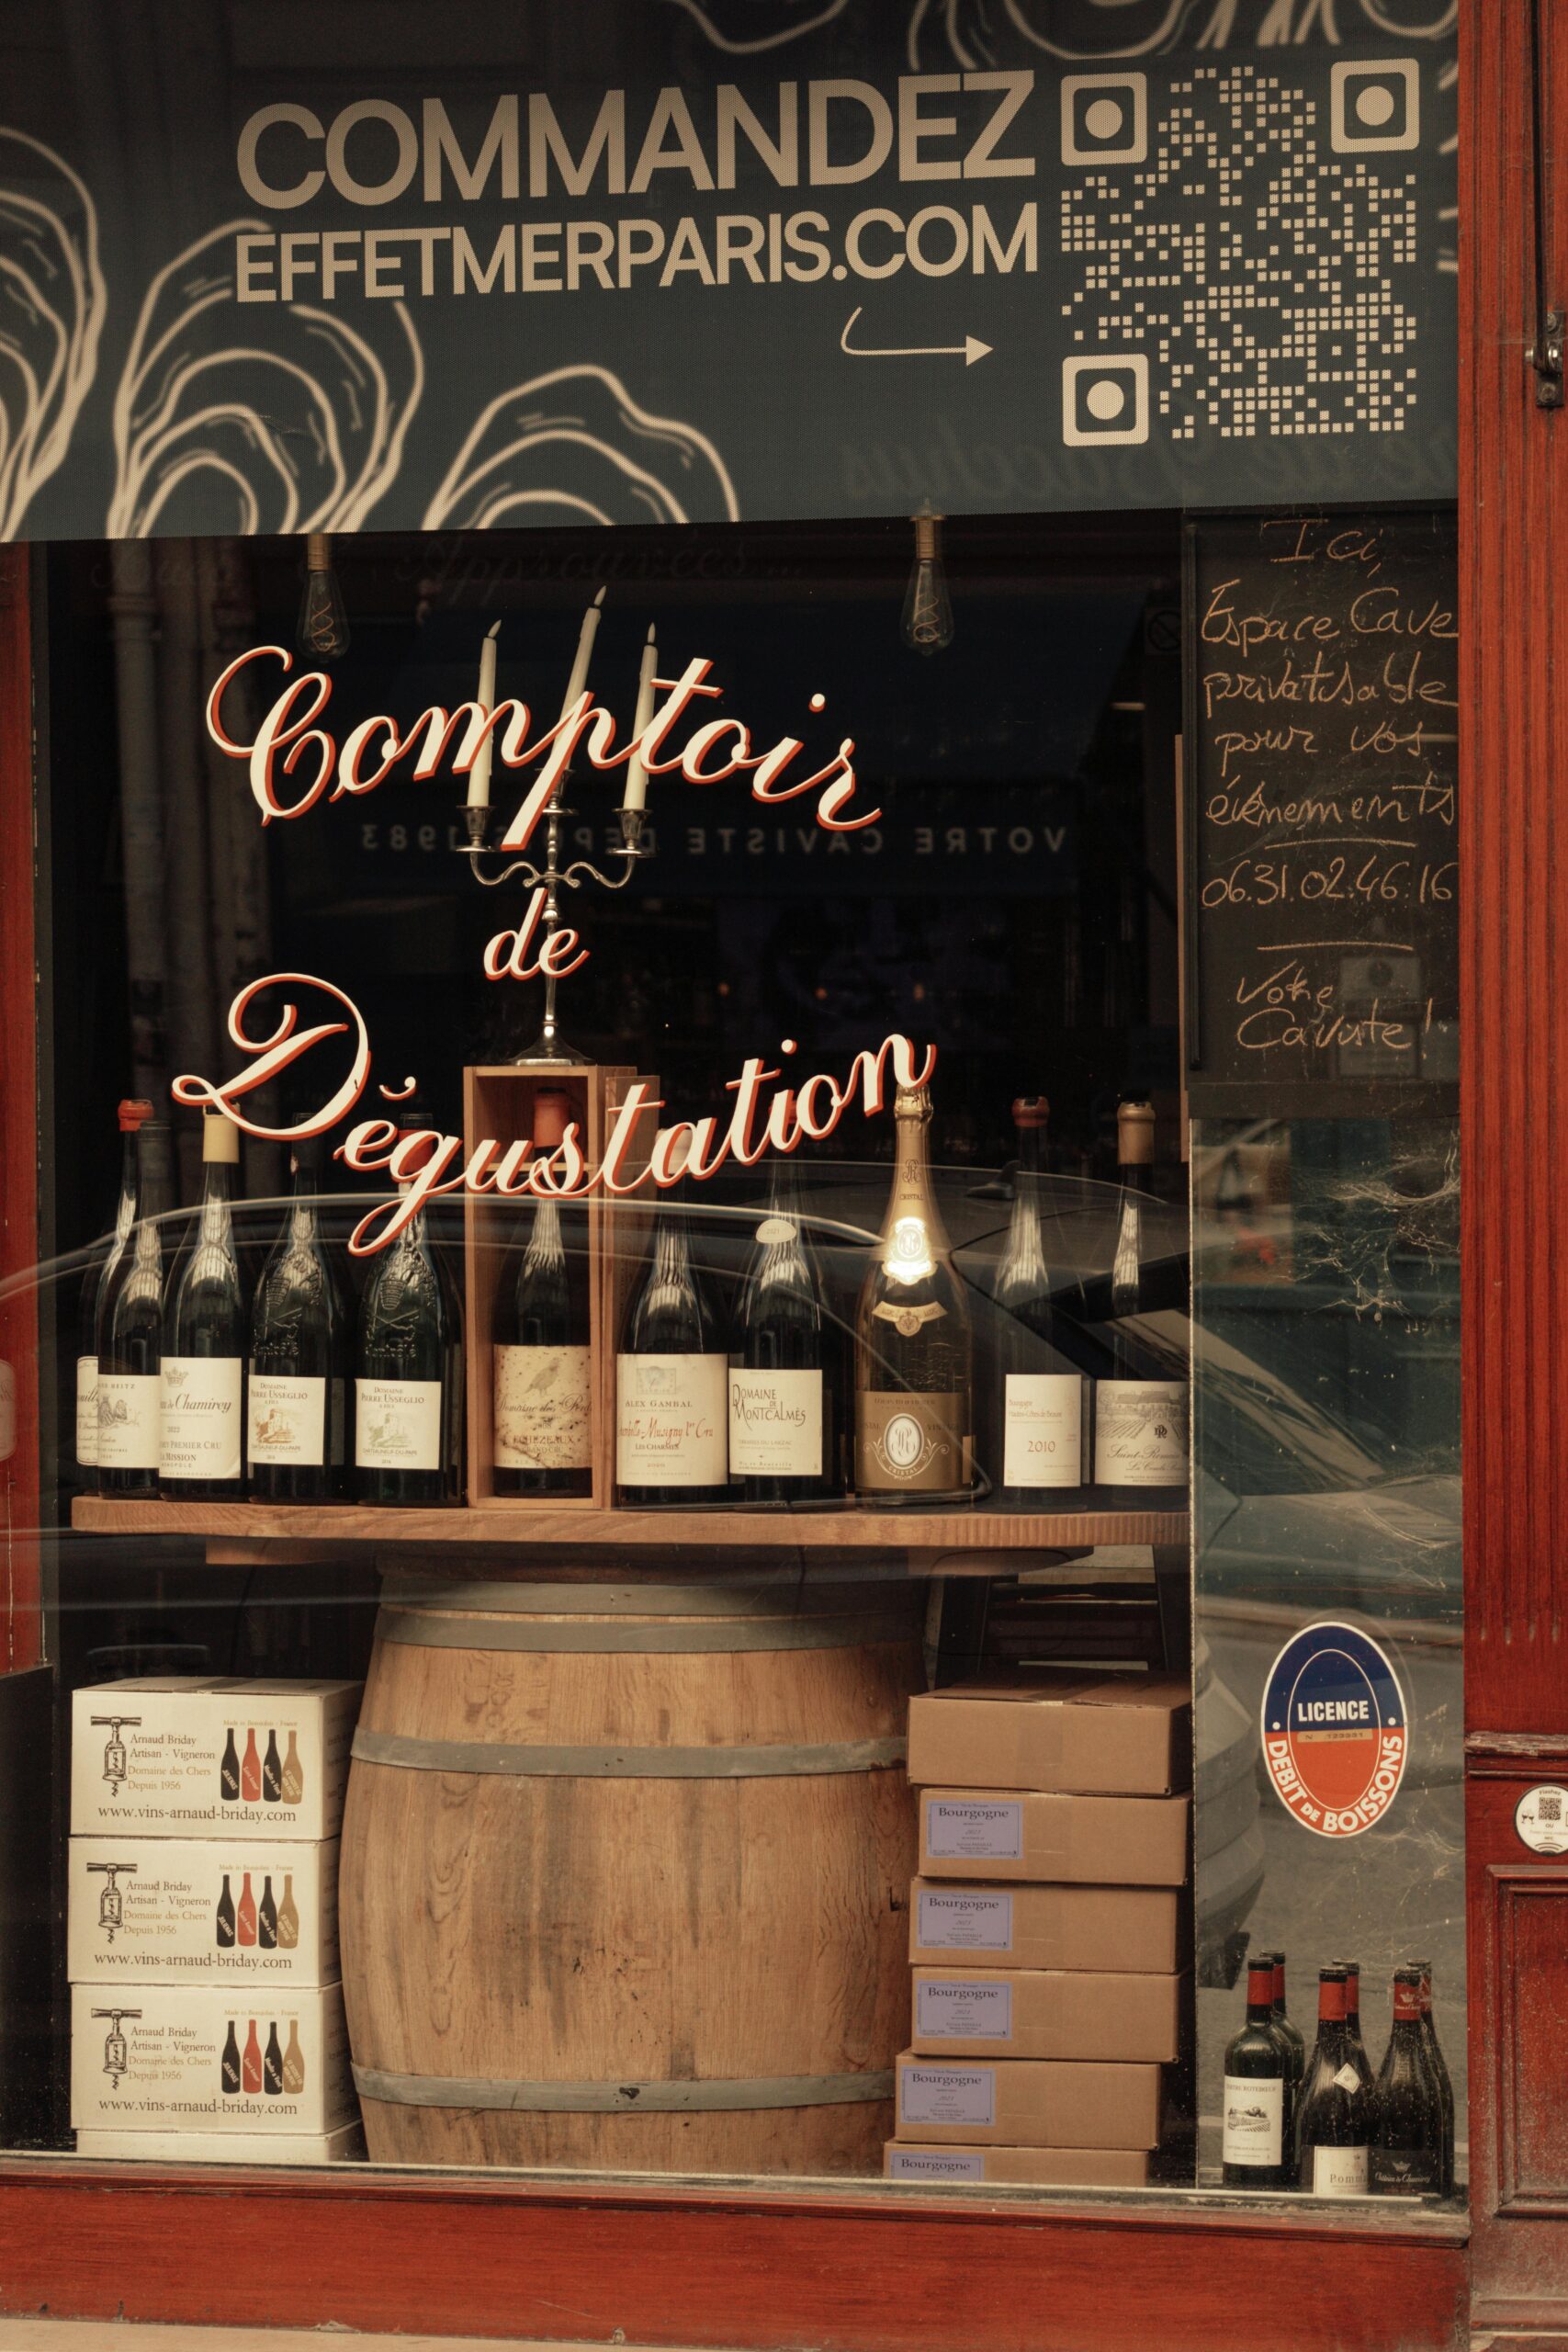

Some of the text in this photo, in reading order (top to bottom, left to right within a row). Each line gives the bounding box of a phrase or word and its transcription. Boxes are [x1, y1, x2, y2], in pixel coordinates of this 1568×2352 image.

[236, 69, 1036, 209] COMMANDEZ
[235, 202, 1039, 303] EFFETMERPARIS.COM
[1201, 578, 1459, 658] Espace Cave
[205, 644, 882, 851] Comptoir
[1214, 721, 1424, 777] pour vos
[482, 887, 590, 981] de
[1235, 958, 1334, 1012] Votre
[171, 972, 937, 1257] Dégustation
[175, 1393, 232, 1414] Chamirey
[625, 1399, 693, 1408] ALEX GAMBAL
[1027, 1440, 1056, 1453] 2010
[1297, 1700, 1370, 1723] LICENCE
[130, 1734, 197, 1747] Arnaud Briday
[130, 1748, 163, 1759] Artisan
[173, 1748, 216, 1761] Vigneron
[128, 1765, 211, 1777] Domaine des Chers
[128, 1780, 182, 1792] Depuis 1956
[1268, 1734, 1404, 1833] DEBIT DE BOISSONS
[97, 1804, 297, 1826] www.vins-arnaud-briday.com
[938, 1806, 1010, 1821] Bourgogne
[126, 1880, 192, 1894] Arnaud Briday
[126, 1894, 158, 1905] Artisan
[168, 1895, 211, 1908] Vigneron
[929, 1897, 1000, 1911] Bourgogne
[123, 1909, 207, 1921] Domaine des Chers
[123, 1925, 177, 1937] Depuis 1956
[94, 1951, 292, 1973] www.vins-arnaud-briday.com
[928, 1986, 998, 2000] Bourgogne
[130, 2026, 197, 2040] Arnaud Briday
[130, 2041, 163, 2052] Artisan
[173, 2041, 216, 2054] Vigneron
[129, 2055, 212, 2066] Domaine des Chers
[129, 2070, 182, 2082] Depuis 1956
[912, 2073, 982, 2086] Bourgogne
[98, 2097, 298, 2118] www.vins-arnaud-briday.com
[901, 2158, 971, 2172] Bourgogne
